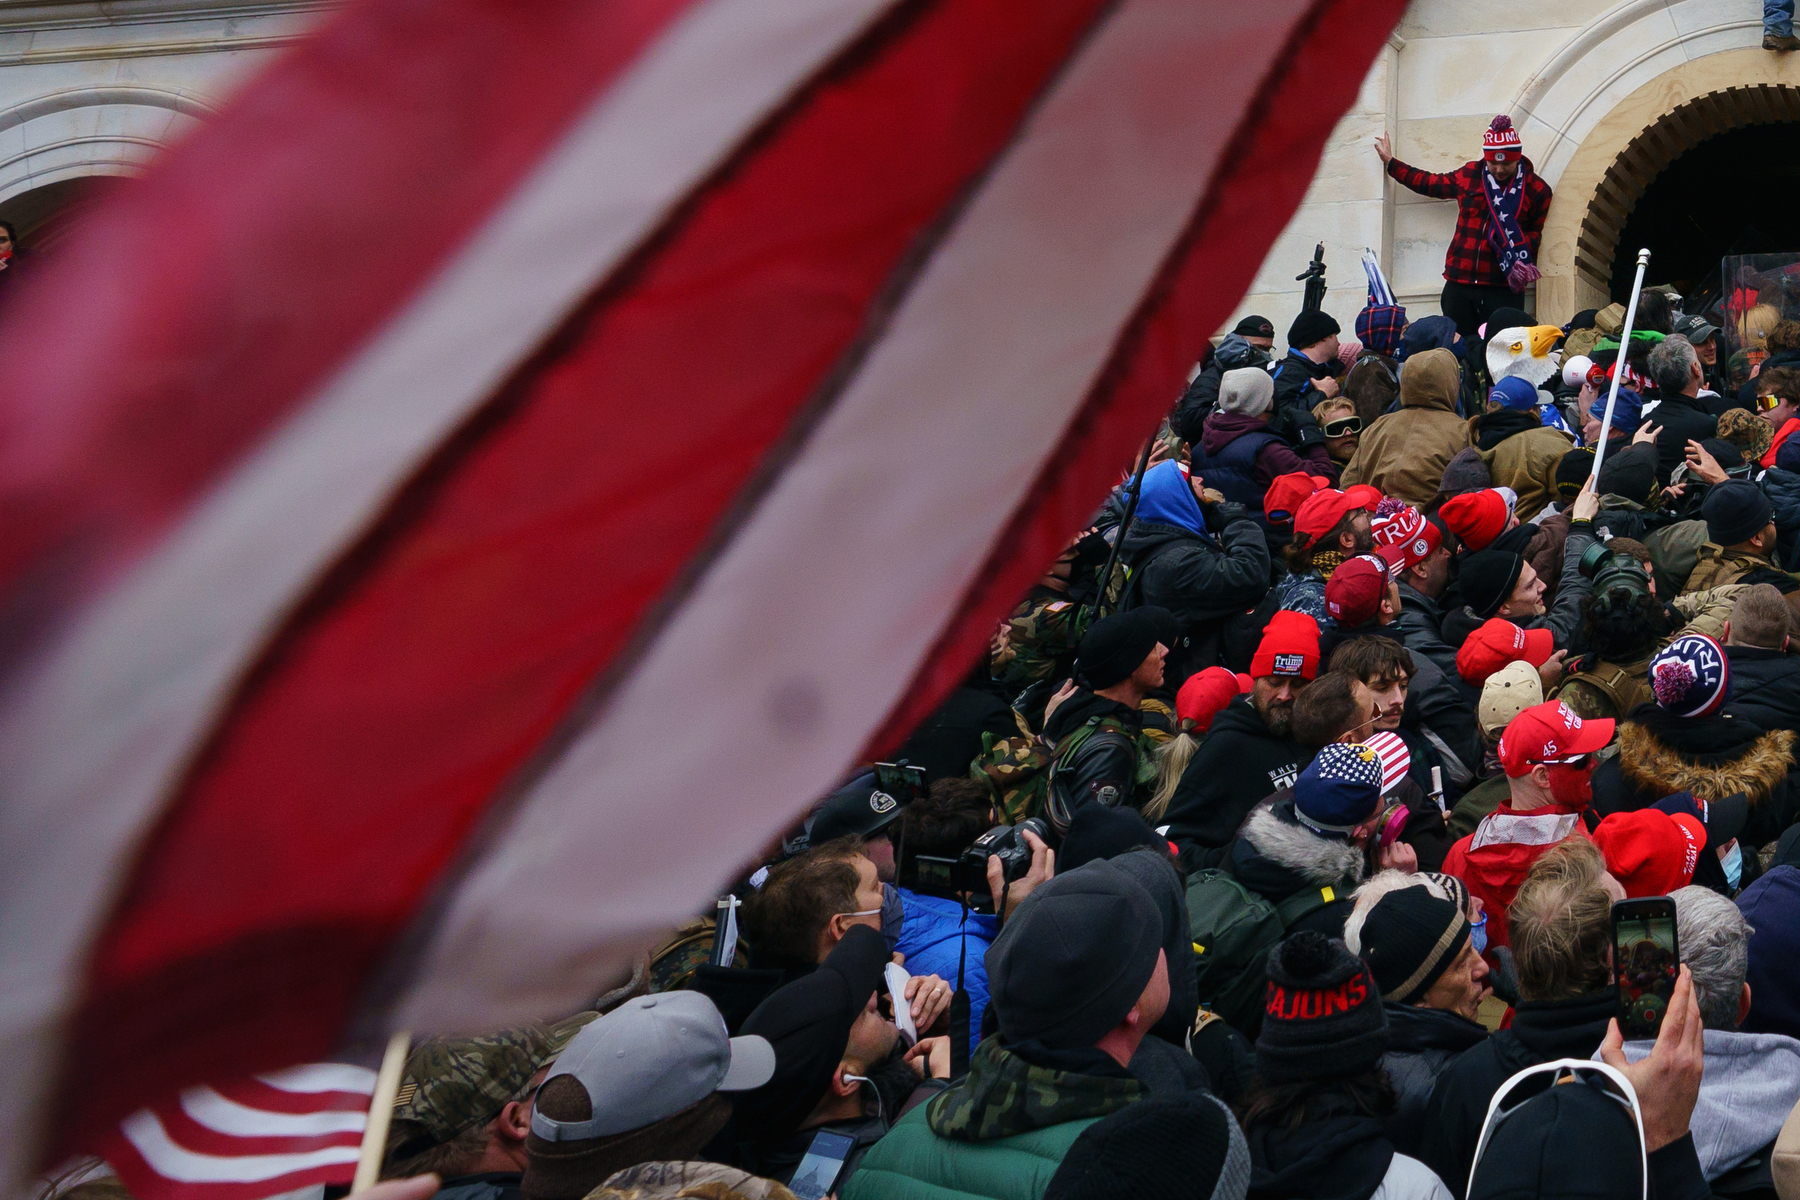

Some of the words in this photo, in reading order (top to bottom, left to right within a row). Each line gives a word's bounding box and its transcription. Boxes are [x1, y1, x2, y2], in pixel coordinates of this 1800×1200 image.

[1416, 542, 1425, 553] 45
[1275, 655, 1303, 668] Trump
[1543, 740, 1557, 757] 45
